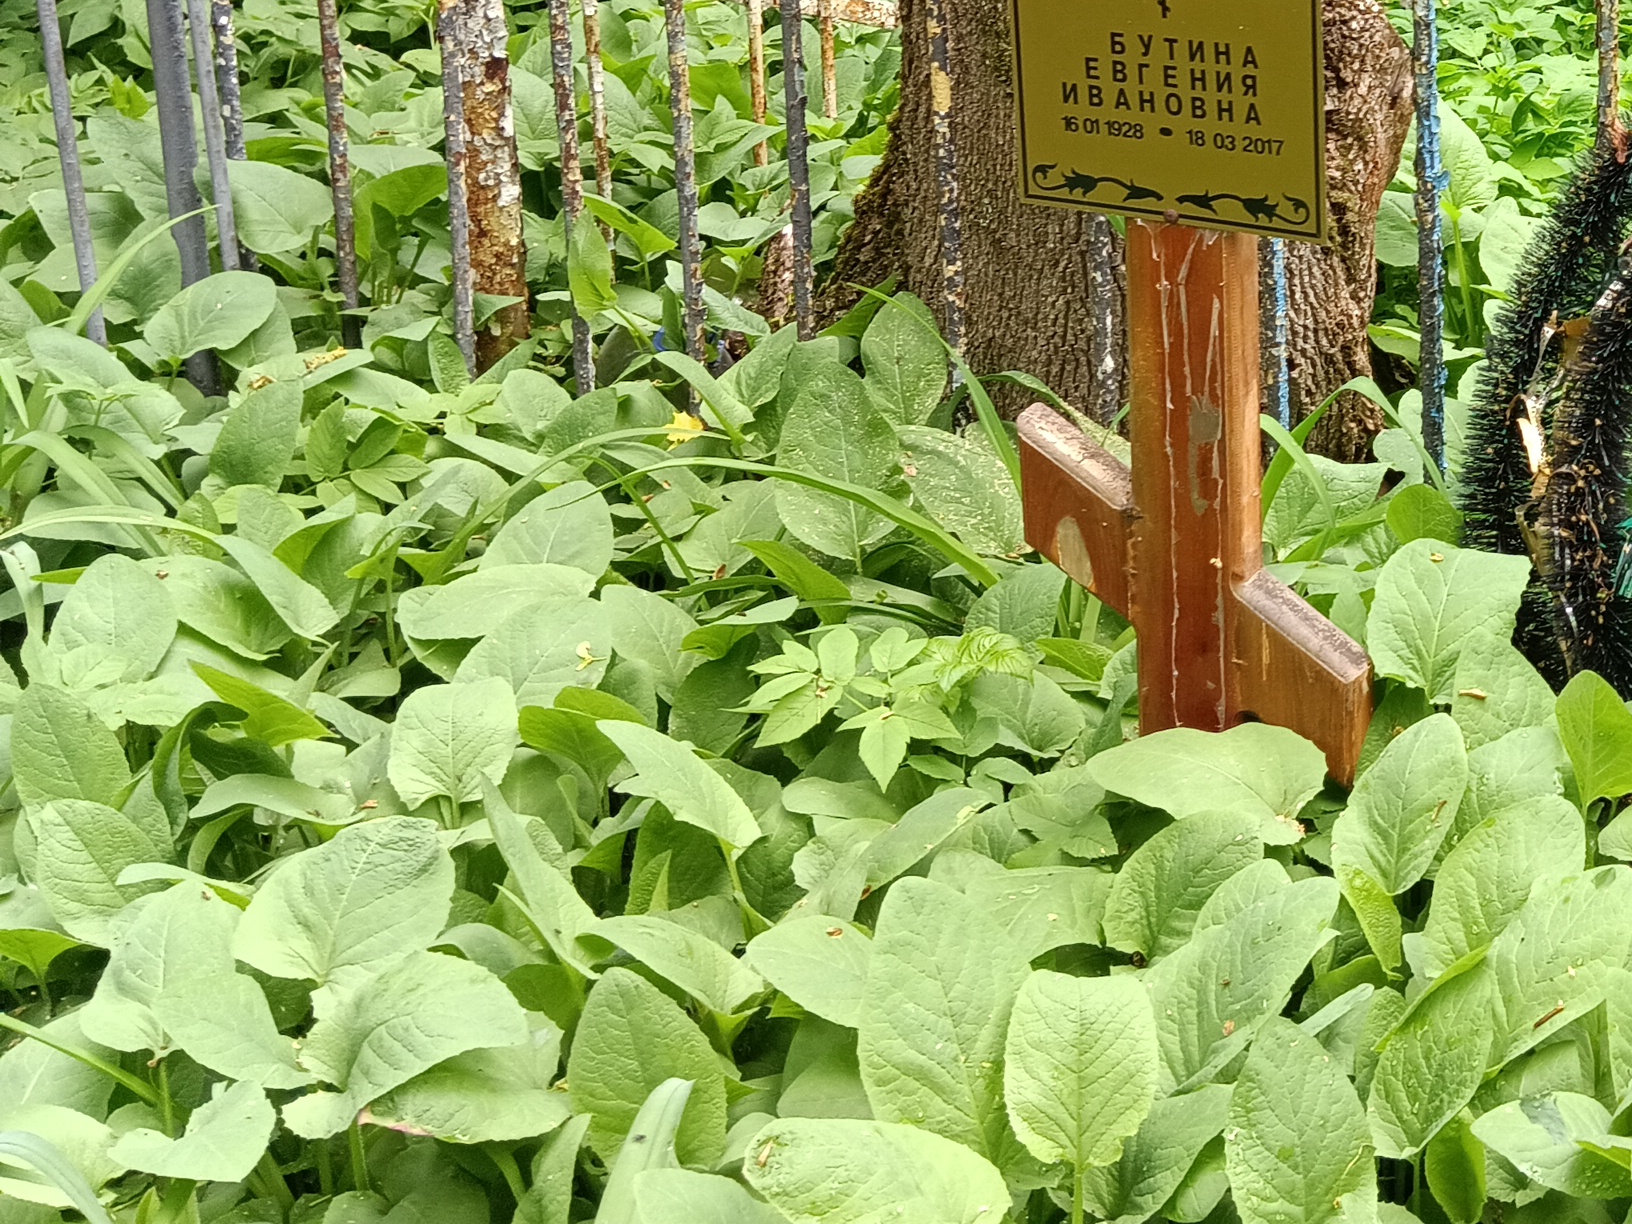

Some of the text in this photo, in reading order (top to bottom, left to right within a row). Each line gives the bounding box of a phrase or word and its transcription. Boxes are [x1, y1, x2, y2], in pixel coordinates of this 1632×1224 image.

[1110, 32, 1260, 70] БУТИНА
[1085, 57, 1259, 98] ЕВГЕНИЯ
[1061, 81, 1262, 126] ИВАНОВНА
[1104, 120, 1144, 140] 1928
[1185, 128, 1206, 147] 18
[1213, 132, 1236, 151] 03
[1242, 136, 1284, 156] 2017
